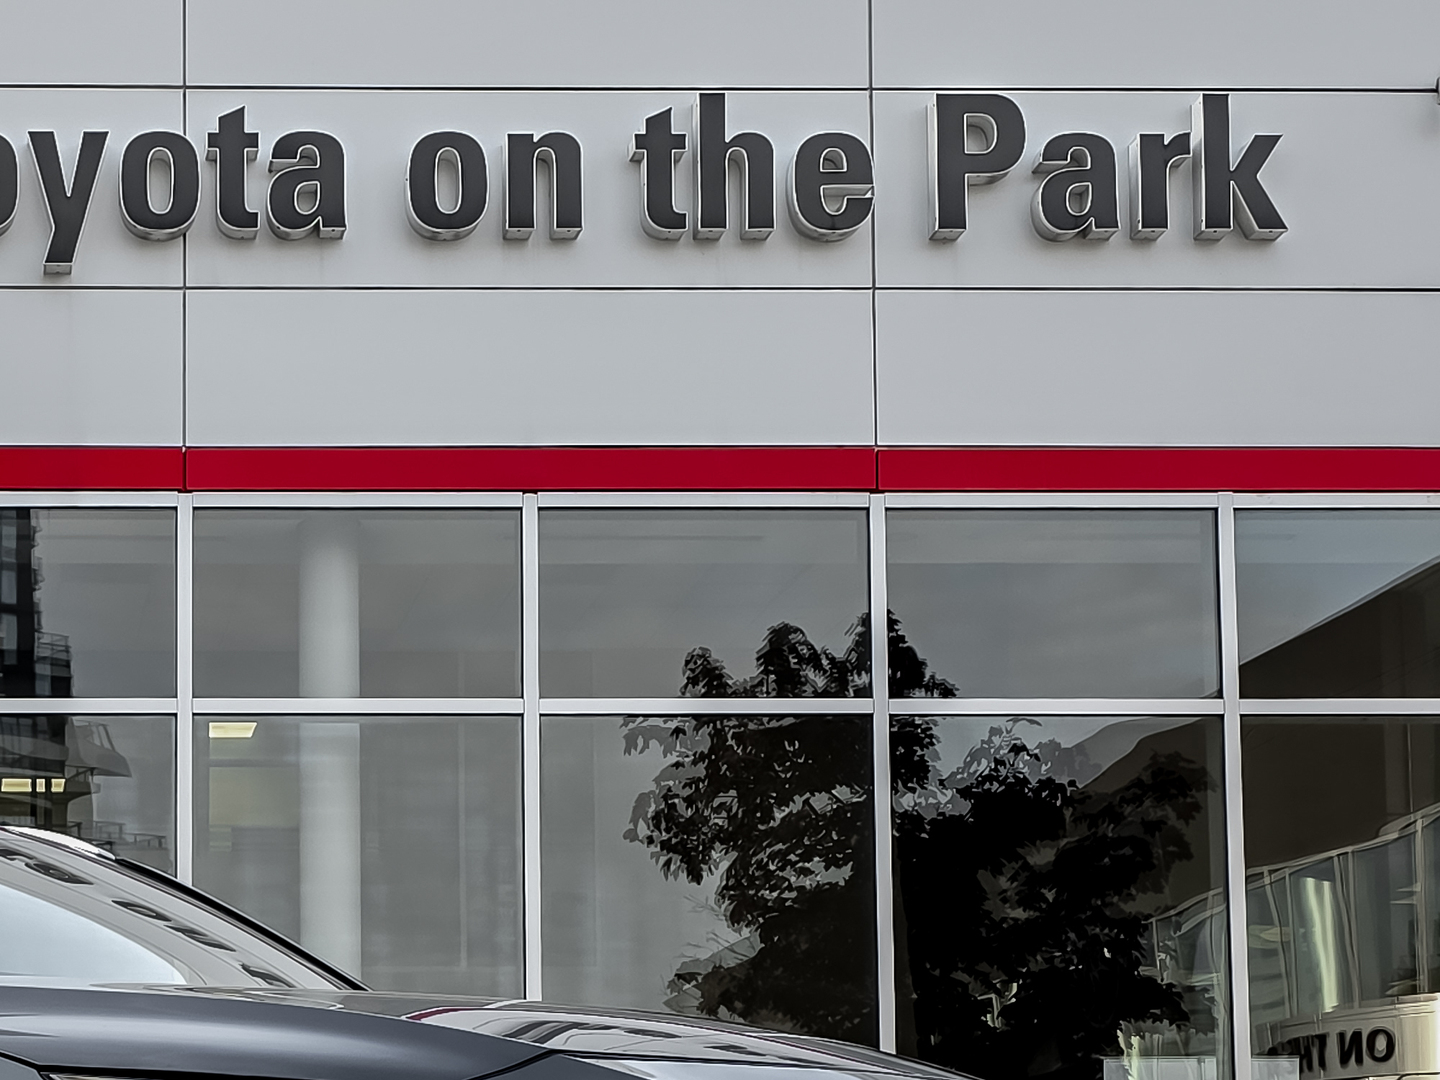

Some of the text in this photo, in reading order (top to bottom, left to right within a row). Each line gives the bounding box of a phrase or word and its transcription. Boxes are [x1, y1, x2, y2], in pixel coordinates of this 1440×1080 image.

[404, 129, 584, 241] on
[628, 92, 875, 242] the
[927, 92, 1288, 242] Park
